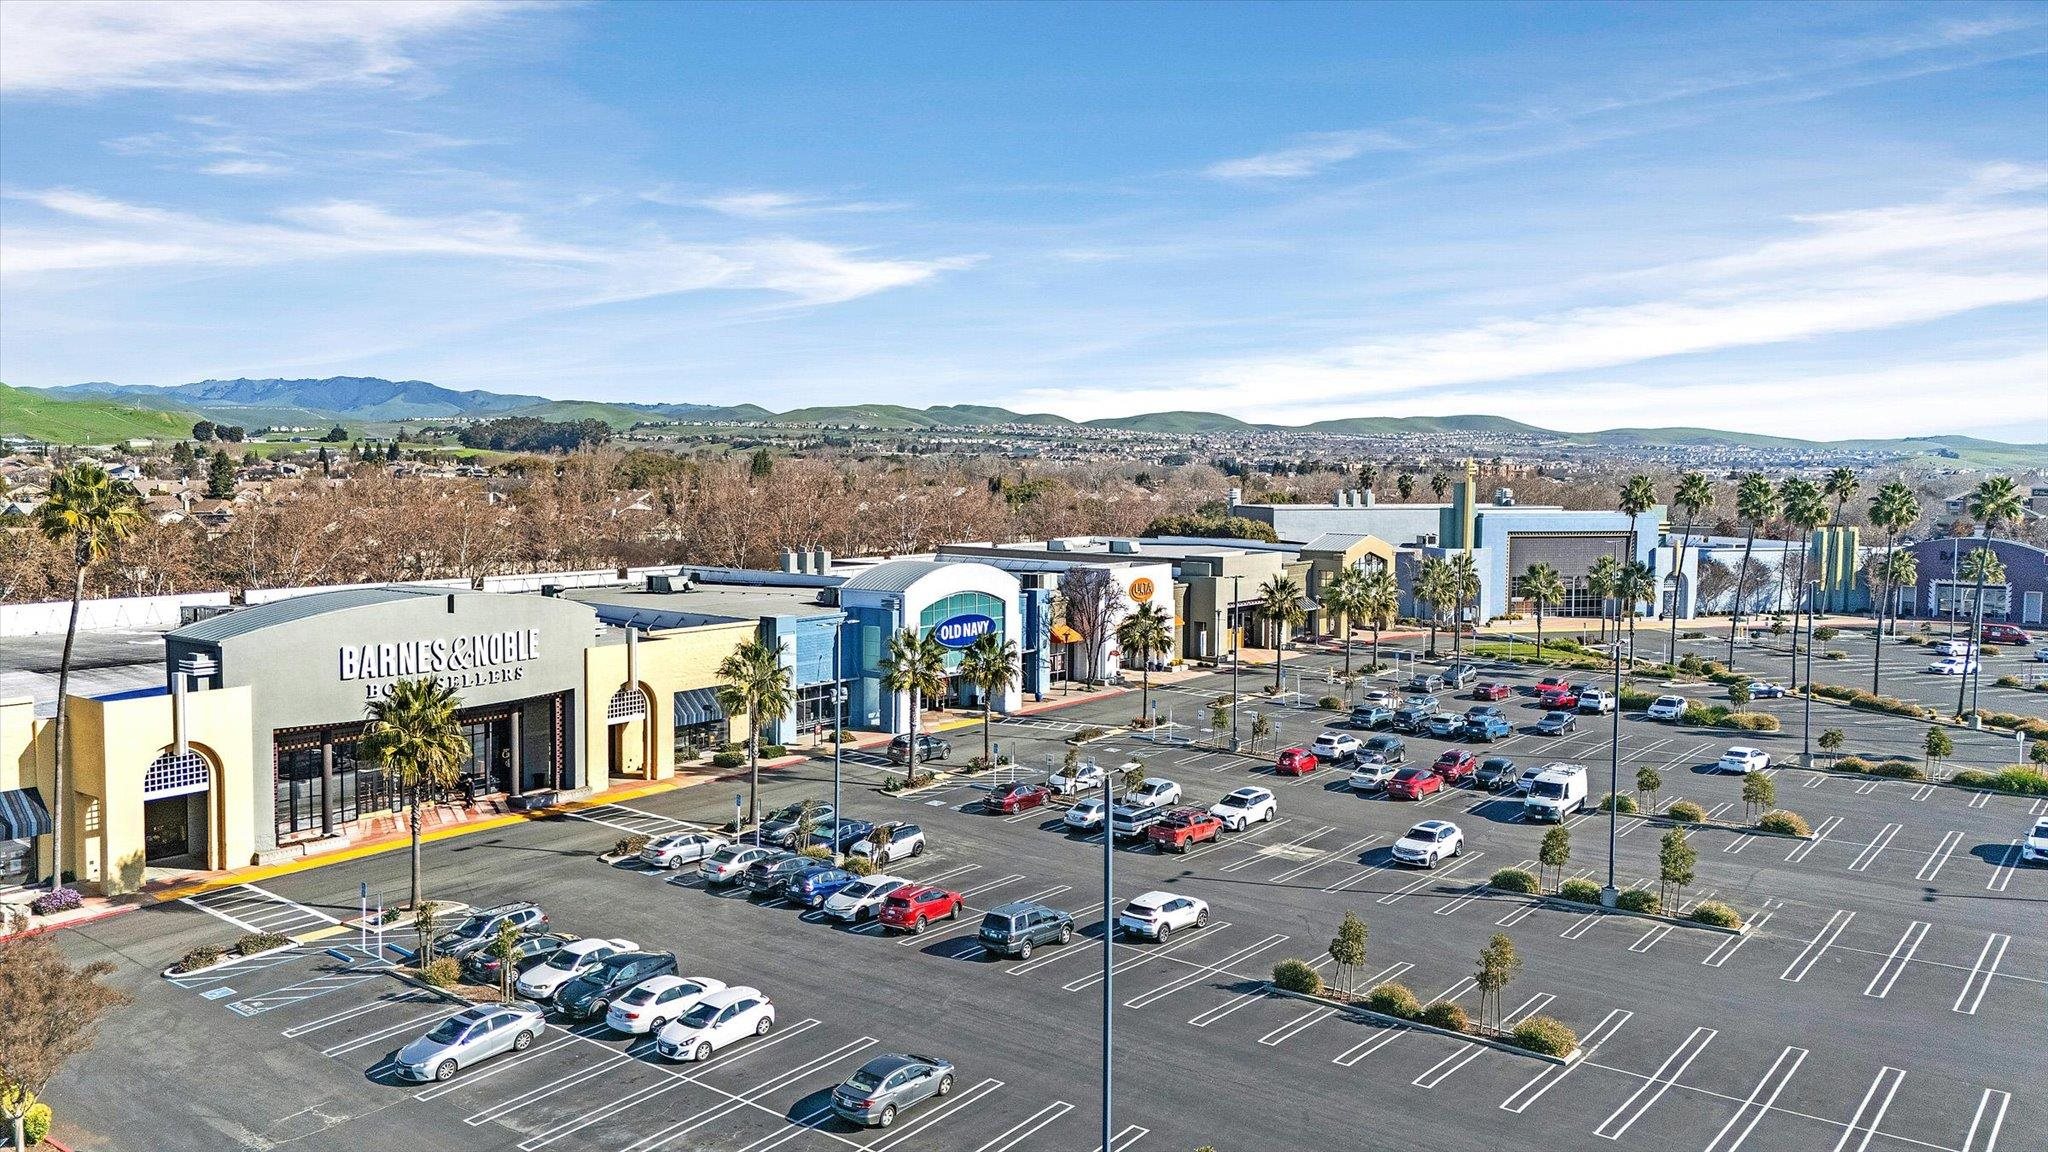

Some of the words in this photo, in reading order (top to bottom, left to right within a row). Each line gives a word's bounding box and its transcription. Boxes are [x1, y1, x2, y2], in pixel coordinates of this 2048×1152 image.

[940, 624, 961, 641] OLD
[962, 620, 990, 638] NAVY
[366, 666, 523, 699] BOSELLERS
